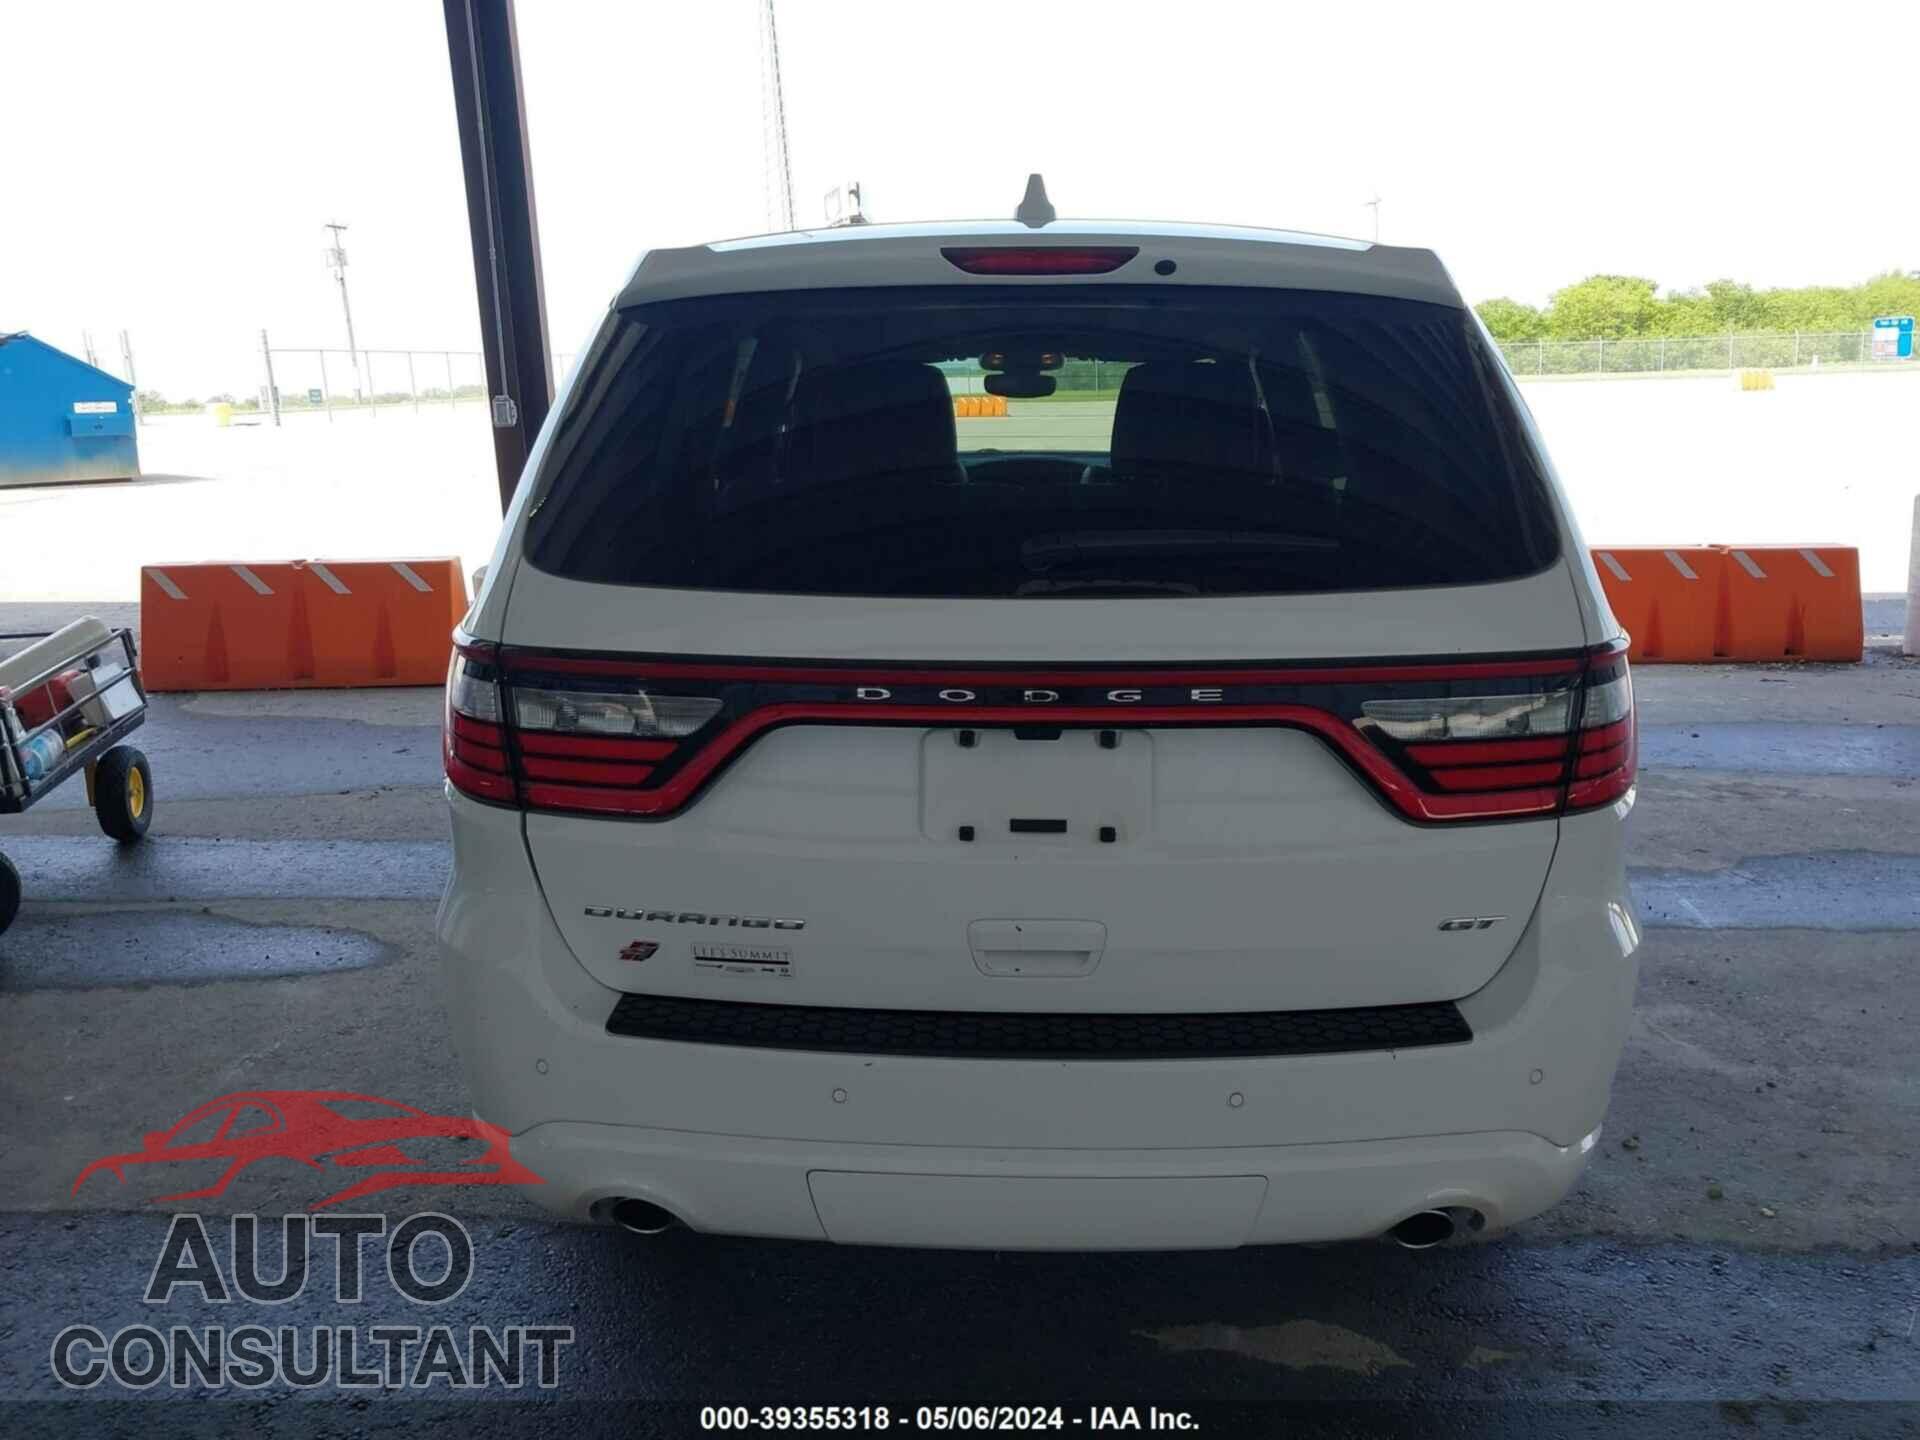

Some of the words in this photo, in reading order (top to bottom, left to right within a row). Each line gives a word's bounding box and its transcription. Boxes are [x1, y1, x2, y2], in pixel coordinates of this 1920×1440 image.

[857, 687, 1223, 702] DODGE
[584, 906, 806, 930] DURANGO
[1438, 916, 1508, 931] GT
